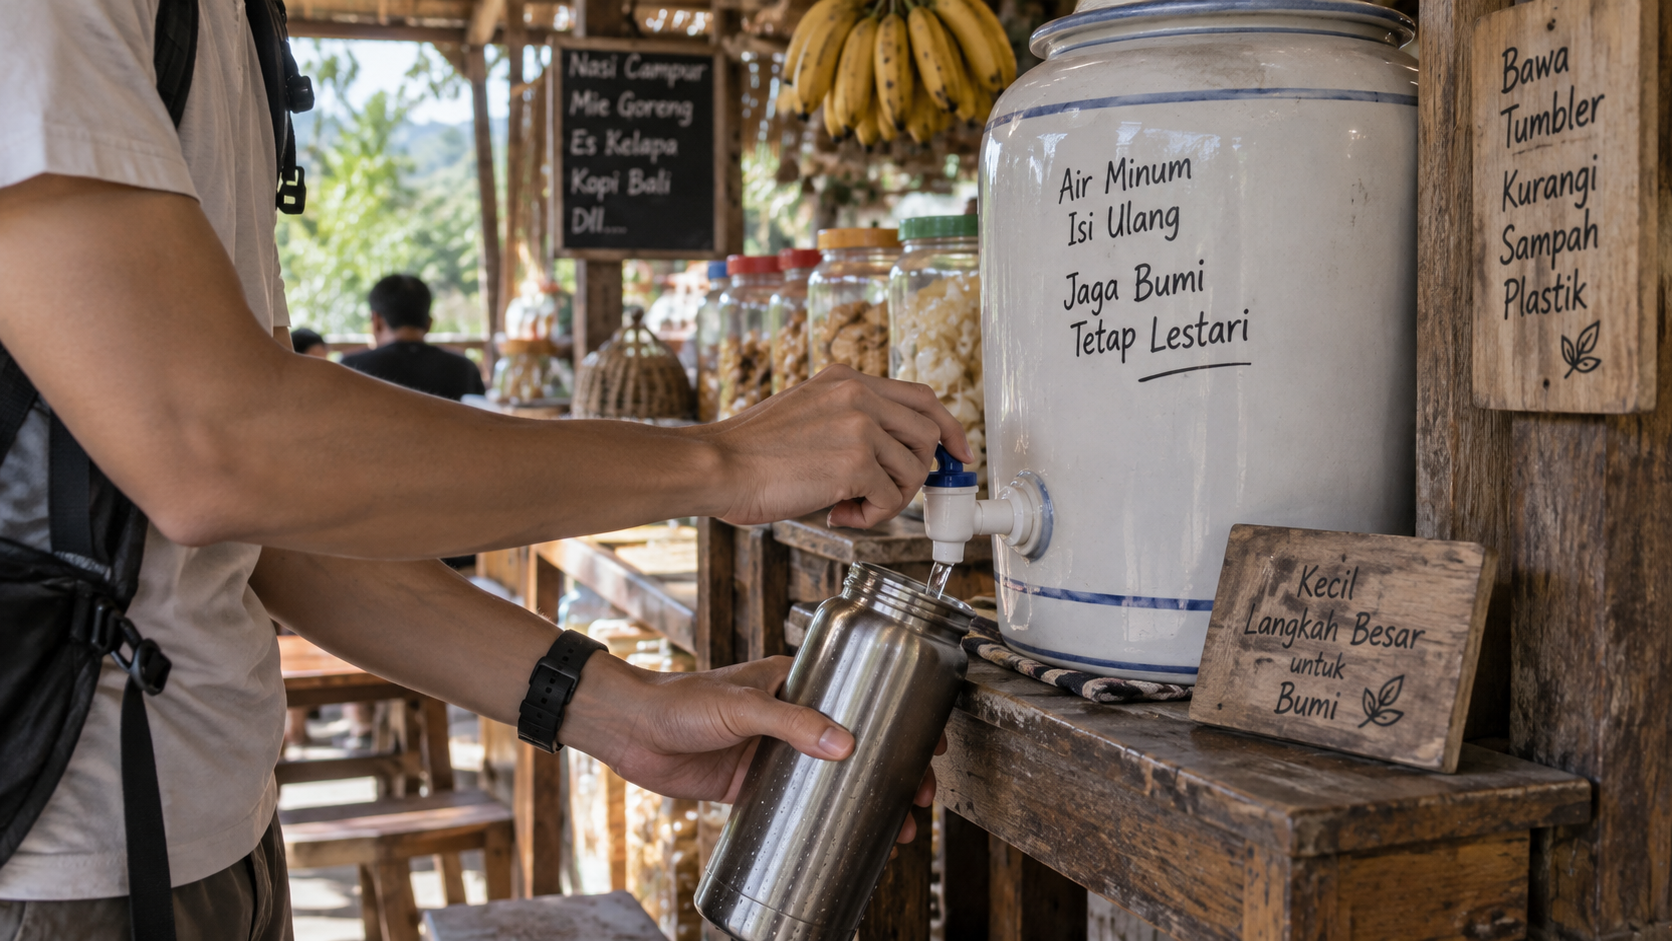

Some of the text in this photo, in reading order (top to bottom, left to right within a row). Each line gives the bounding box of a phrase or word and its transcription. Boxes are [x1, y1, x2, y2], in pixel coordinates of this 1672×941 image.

[569, 52, 708, 88] Nasi Campur
[1501, 47, 1569, 94] Bawa
[569, 90, 694, 127] Mie Goreng
[1500, 85, 1606, 149] Tumbler
[570, 129, 679, 164] Es Kelapa
[570, 167, 672, 202] Kopi Bali
[1058, 157, 1192, 204] Air Minum
[1502, 153, 1598, 212] Kurangi
[1068, 200, 1180, 246] Isi Ulang
[1500, 207, 1599, 271] Sampah
[1063, 259, 1205, 316] Jaga Bumi
[1503, 268, 1588, 321] Plastik
[1070, 308, 1249, 364] Tetap Lestari
[1297, 565, 1359, 600] Kecil
[1243, 603, 1426, 649] Langkah Besar
[1290, 651, 1346, 680] untuk
[1273, 681, 1341, 720] Bumi
